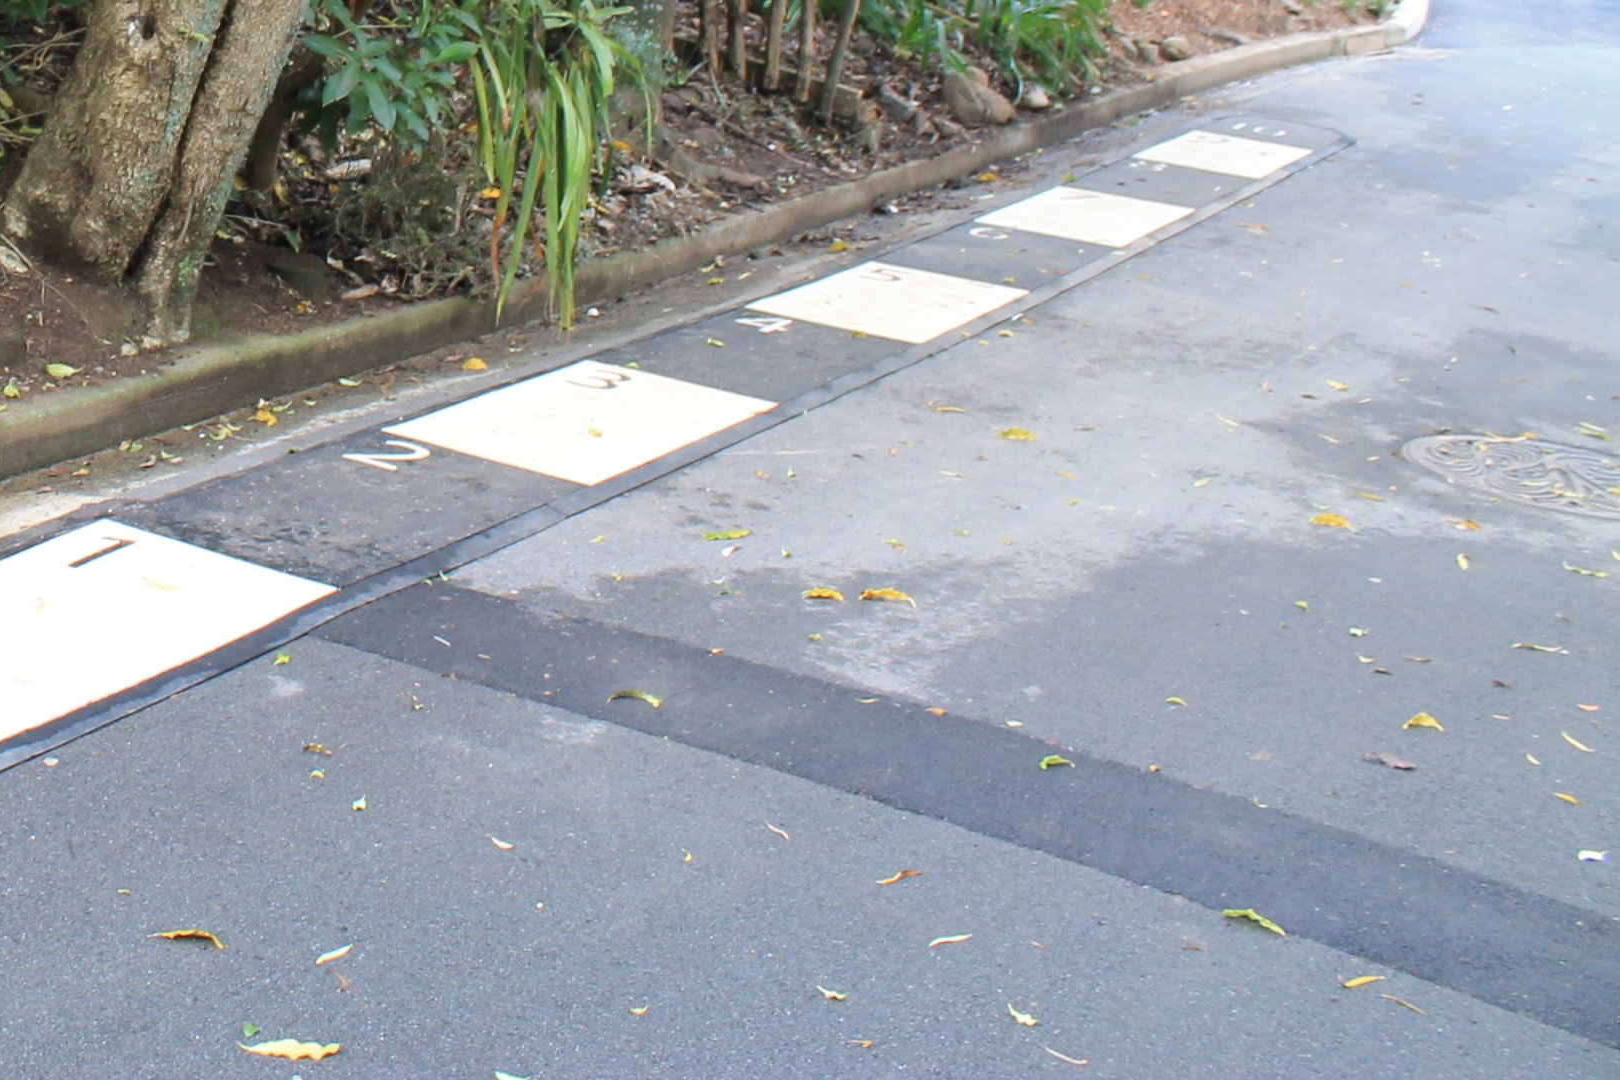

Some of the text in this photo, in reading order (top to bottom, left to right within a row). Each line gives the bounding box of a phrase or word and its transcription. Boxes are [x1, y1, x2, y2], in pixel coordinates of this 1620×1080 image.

[857, 267, 910, 282] 5
[734, 318, 793, 333] 4
[565, 370, 631, 389] 3
[342, 440, 430, 472] 2
[67, 536, 137, 568] 1
